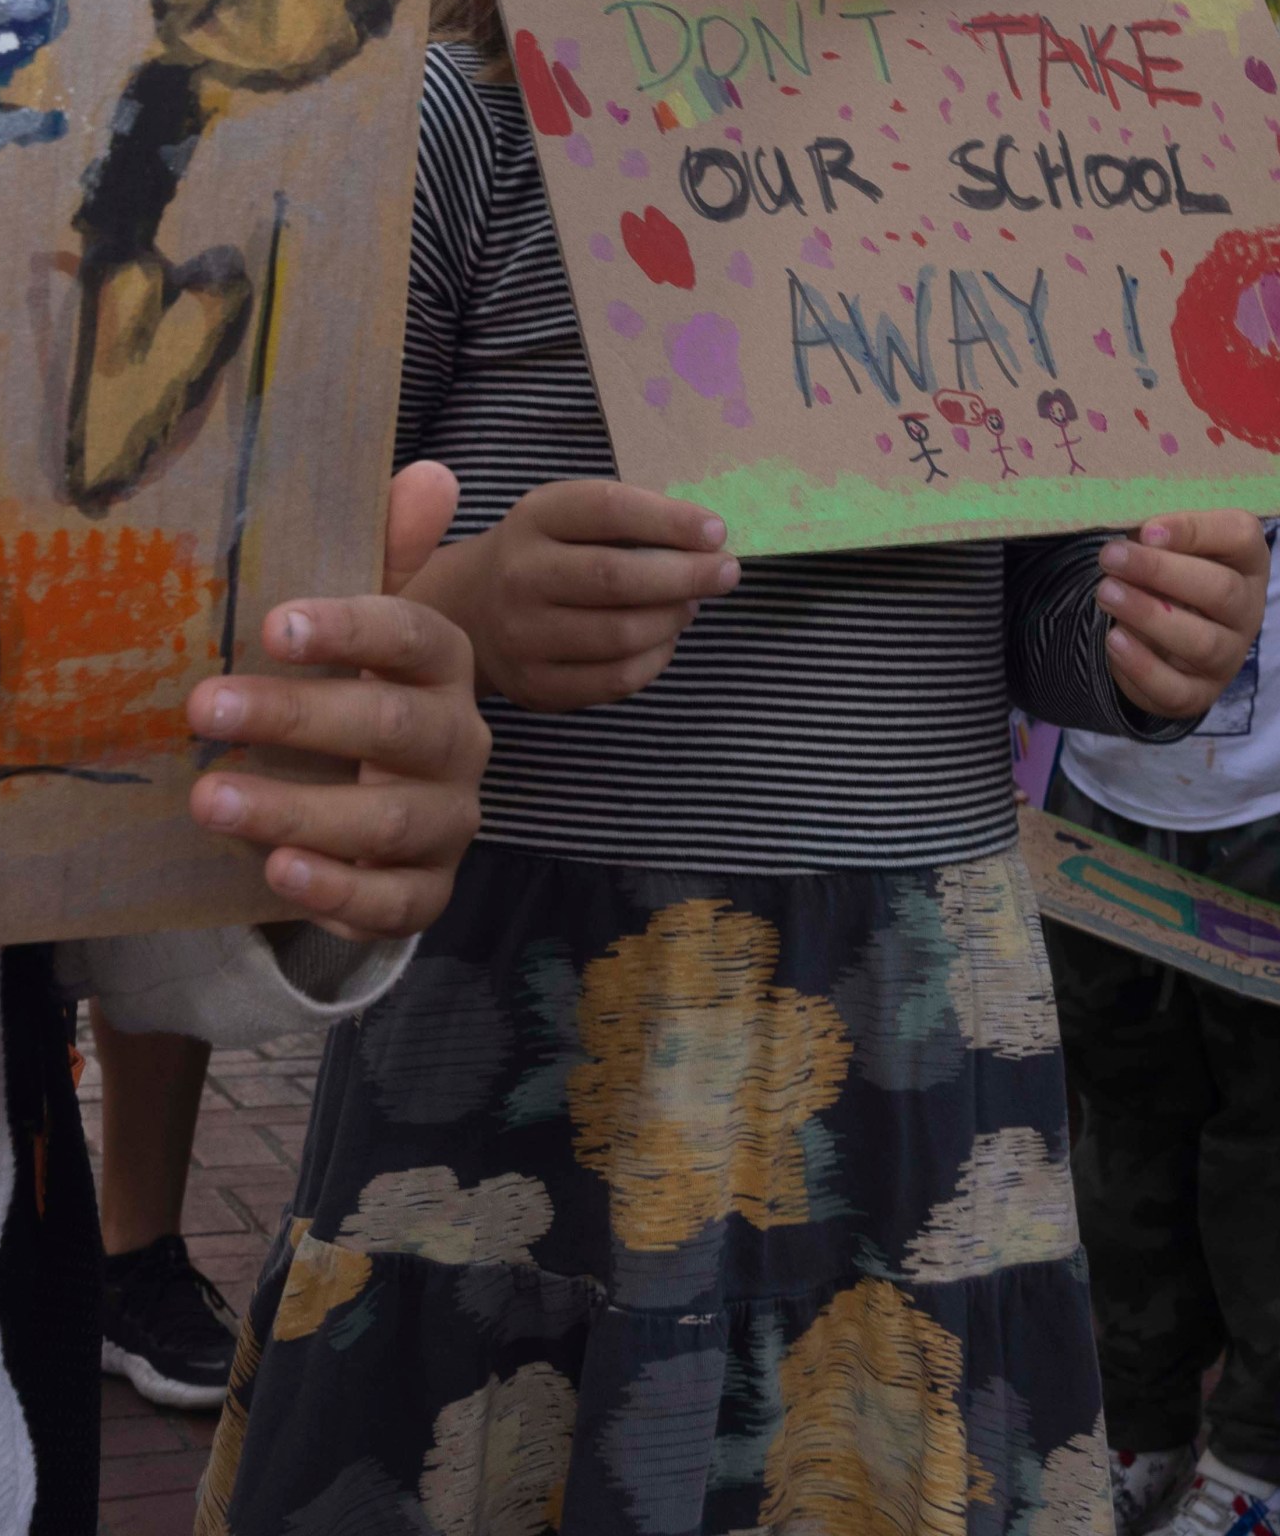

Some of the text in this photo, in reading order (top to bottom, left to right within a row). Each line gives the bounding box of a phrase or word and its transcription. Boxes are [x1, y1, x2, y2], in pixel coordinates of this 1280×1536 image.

[960, 11, 1202, 109] TAKE
[680, 128, 1232, 221] OUR SCHOOL
